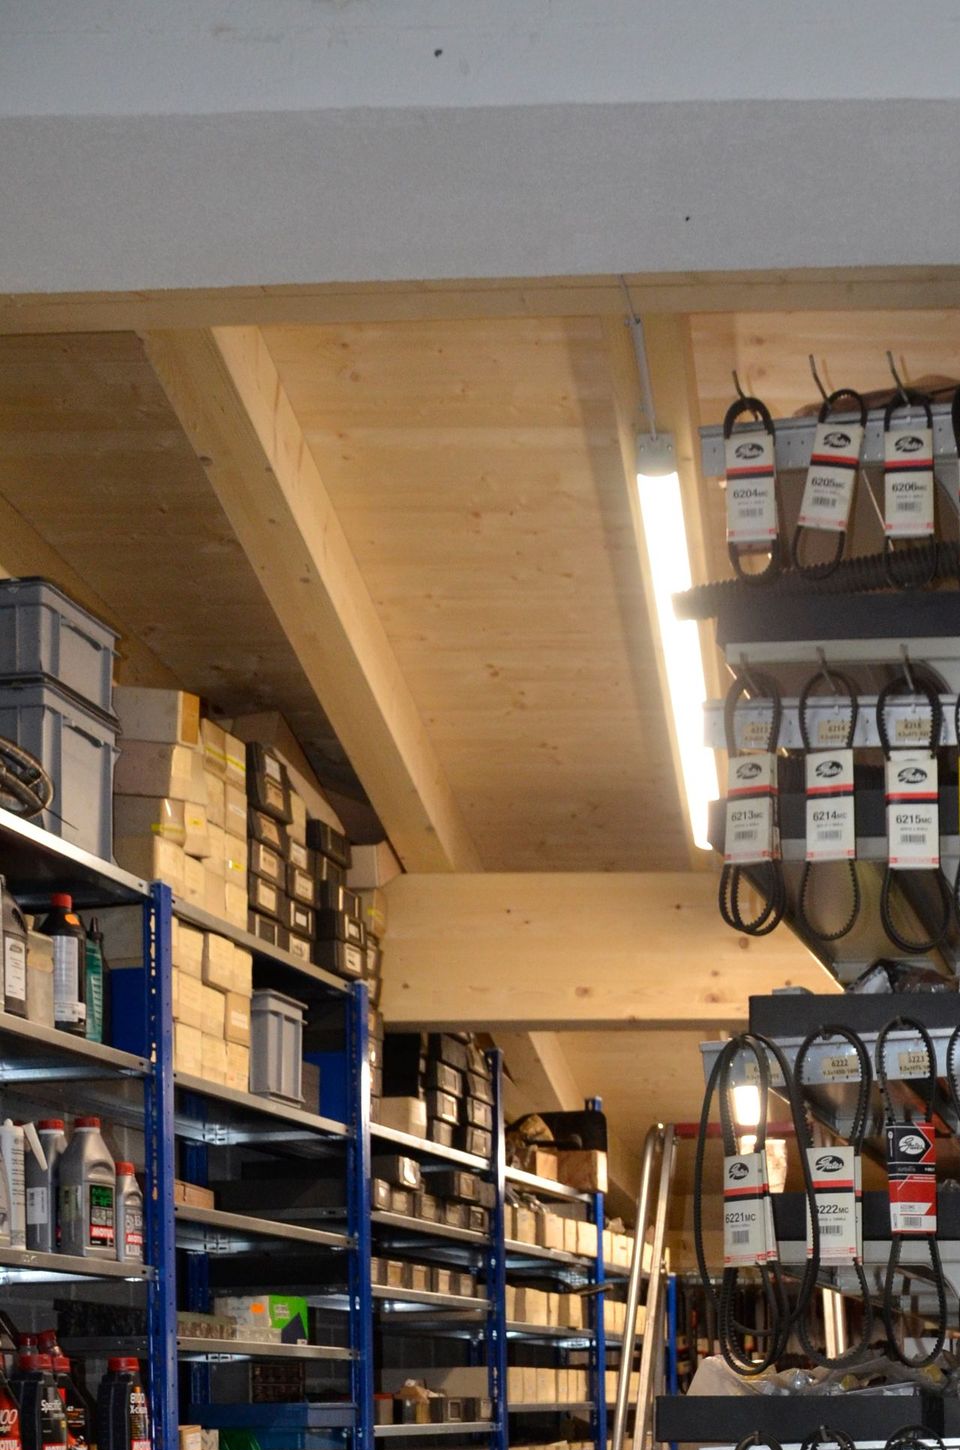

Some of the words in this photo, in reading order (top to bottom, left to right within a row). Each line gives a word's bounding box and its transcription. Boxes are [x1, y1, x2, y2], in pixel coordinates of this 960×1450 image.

[896, 815, 932, 824] 6215MC
[899, 1136, 926, 1154] Gates
[815, 1155, 844, 1172] Gates
[726, 1212, 756, 1222] 6221MC
